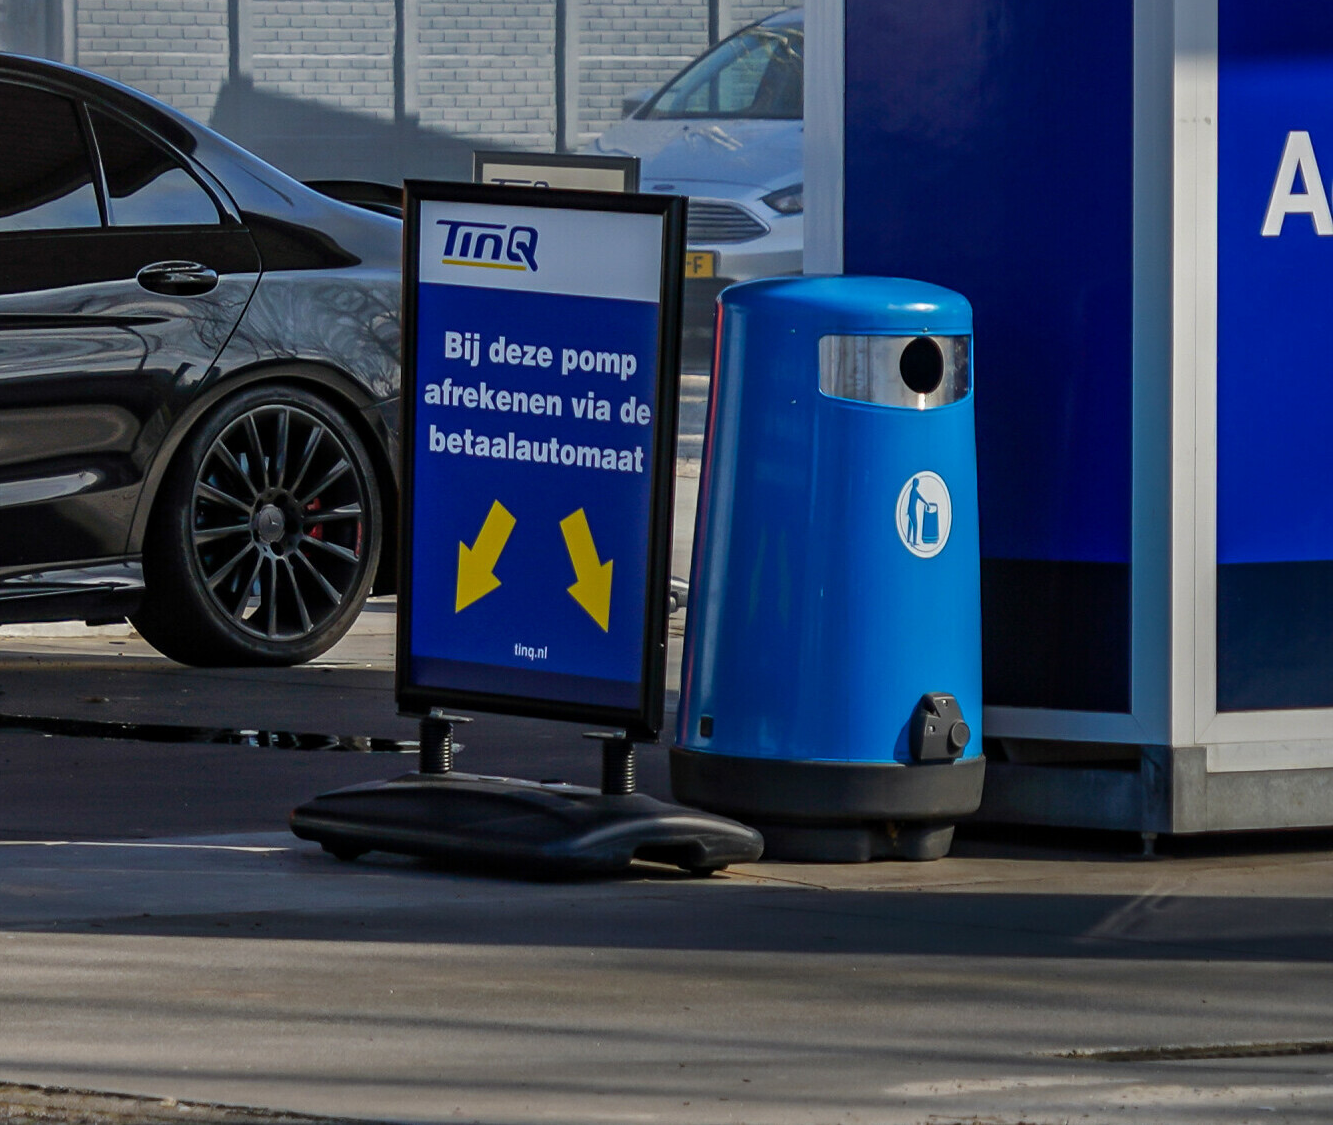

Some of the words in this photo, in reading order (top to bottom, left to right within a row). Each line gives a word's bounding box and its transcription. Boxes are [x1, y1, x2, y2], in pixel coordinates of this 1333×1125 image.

[1260, 131, 1333, 237] A
[436, 219, 539, 272] TinQ
[444, 331, 480, 367] Bij
[489, 336, 553, 368] deze
[561, 348, 637, 381] pomp
[424, 378, 562, 416] afrekenen
[571, 391, 611, 421] via
[620, 396, 651, 425] de
[429, 424, 644, 473] betaalautomaat
[514, 642, 548, 661] tinq.nl
